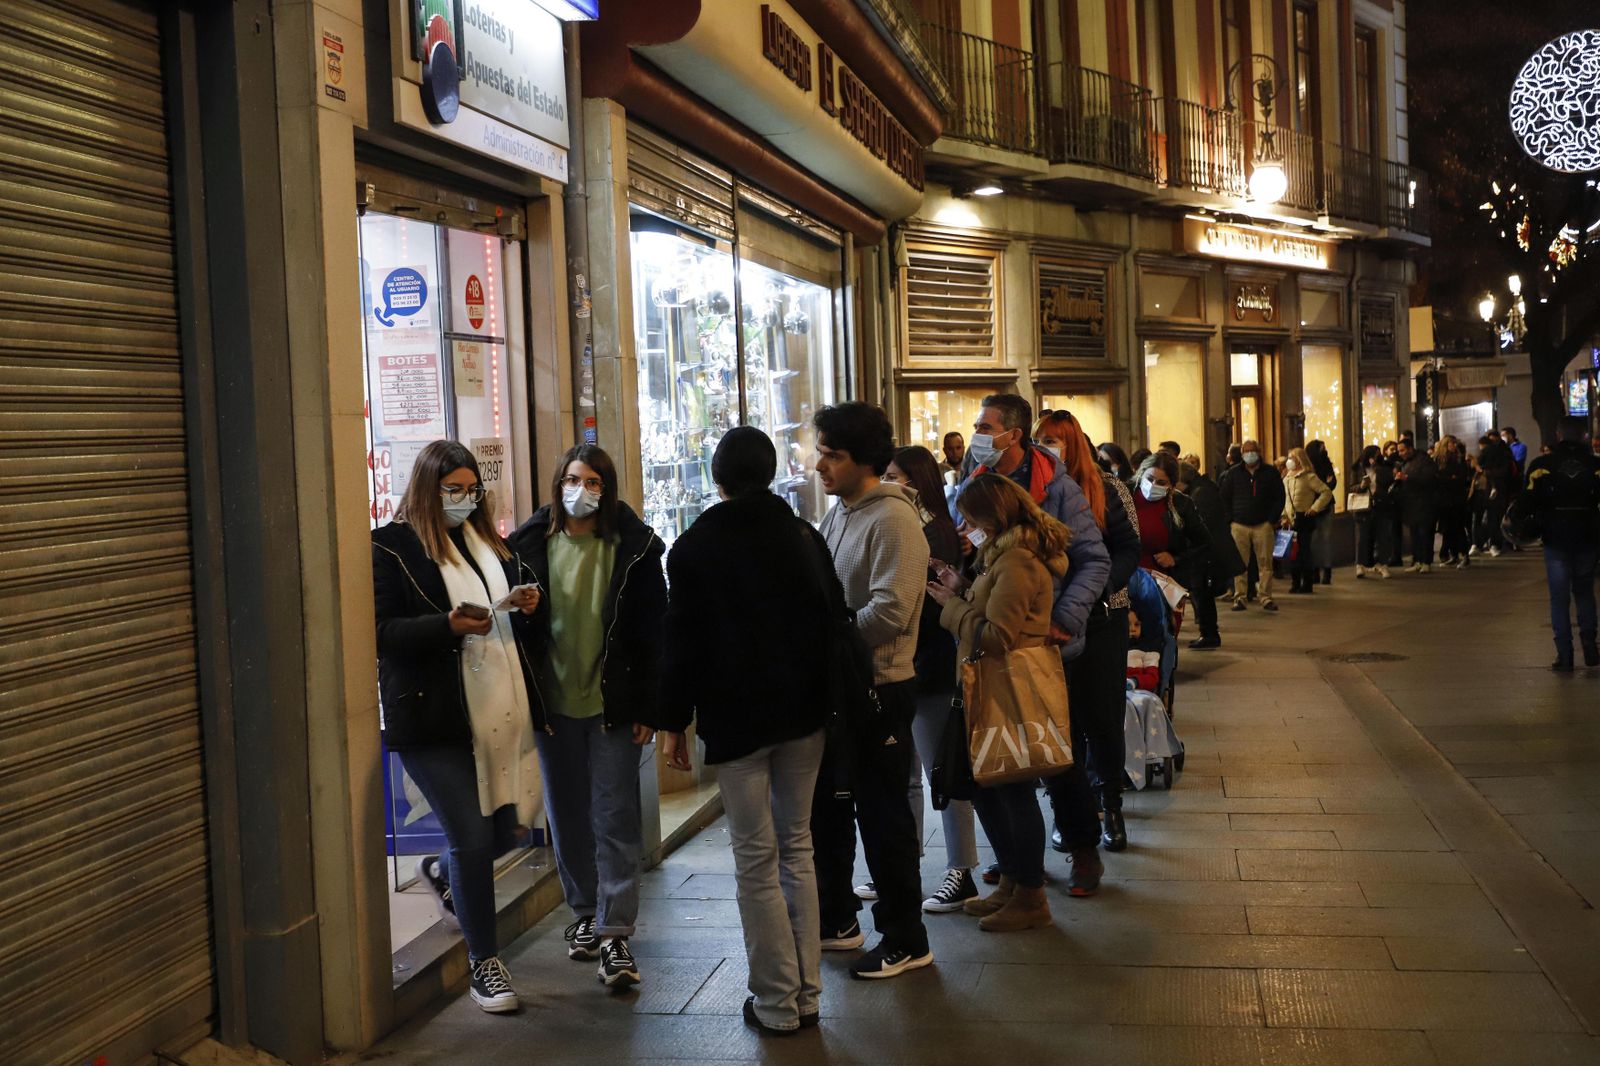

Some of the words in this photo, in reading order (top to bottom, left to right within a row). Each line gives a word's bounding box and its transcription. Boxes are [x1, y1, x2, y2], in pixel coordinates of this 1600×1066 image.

[508, 28, 515, 55] y
[467, 51, 515, 97] Apuestas
[517, 76, 532, 107] del
[533, 85, 564, 122] Estado
[483, 124, 545, 167] Administración
[558, 155, 564, 174] 4
[468, 280, 480, 298] +18
[387, 356, 428, 366] BOTES
[481, 444, 504, 457] PREMIO
